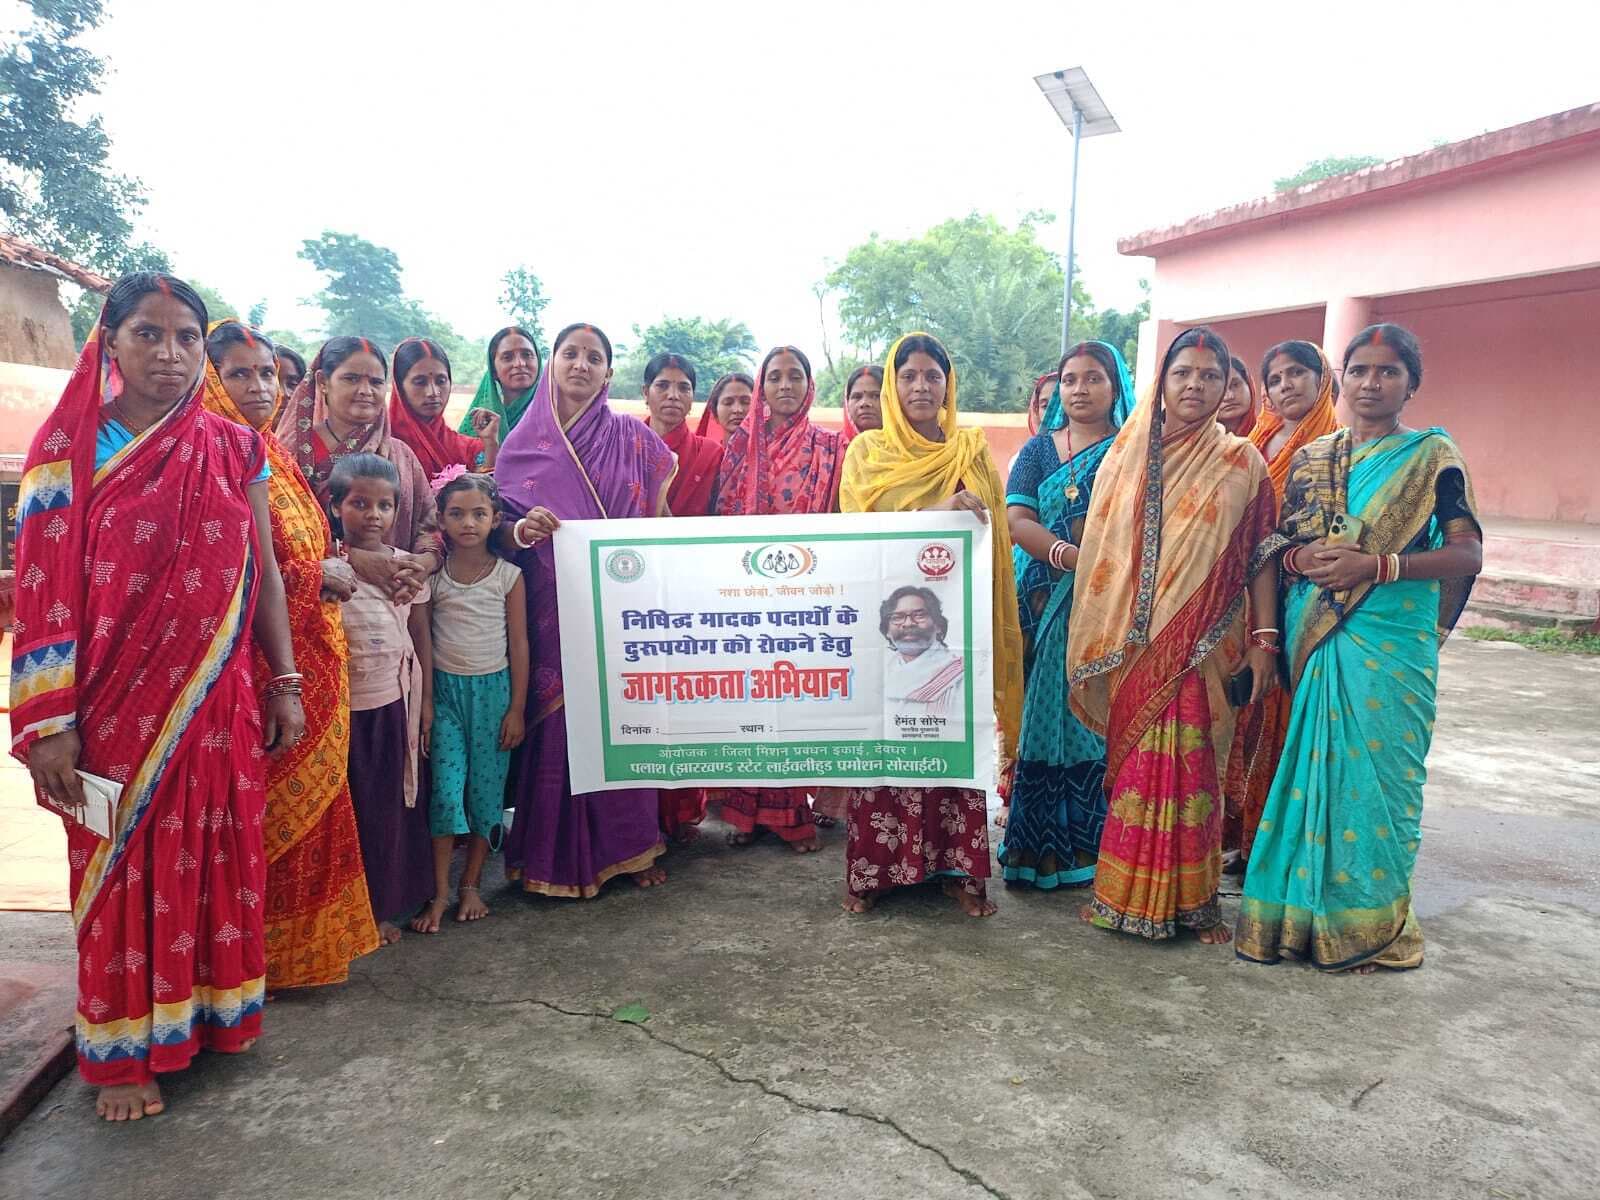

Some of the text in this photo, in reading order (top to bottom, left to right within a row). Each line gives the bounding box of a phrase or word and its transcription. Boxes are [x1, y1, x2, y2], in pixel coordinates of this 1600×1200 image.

[776, 584, 805, 596] जीवन
[622, 605, 859, 630] निषिद्ध मादक पदार्थों के
[623, 633, 853, 662] दुरूपयोग को रोकने हेतु
[621, 661, 850, 702] जागरूकता अभियान
[895, 714, 946, 726] हेमंत सोरेन
[621, 725, 651, 735] दिनांक
[740, 724, 764, 733] स्थान
[659, 746, 707, 758] आयोजक
[721, 745, 751, 757] जिला
[756, 744, 789, 757] मिशन
[874, 743, 906, 755] देवघर
[630, 762, 666, 774] पलाश
[737, 758, 762, 773] स्टेट
[837, 757, 883, 772] प्रमोशन
